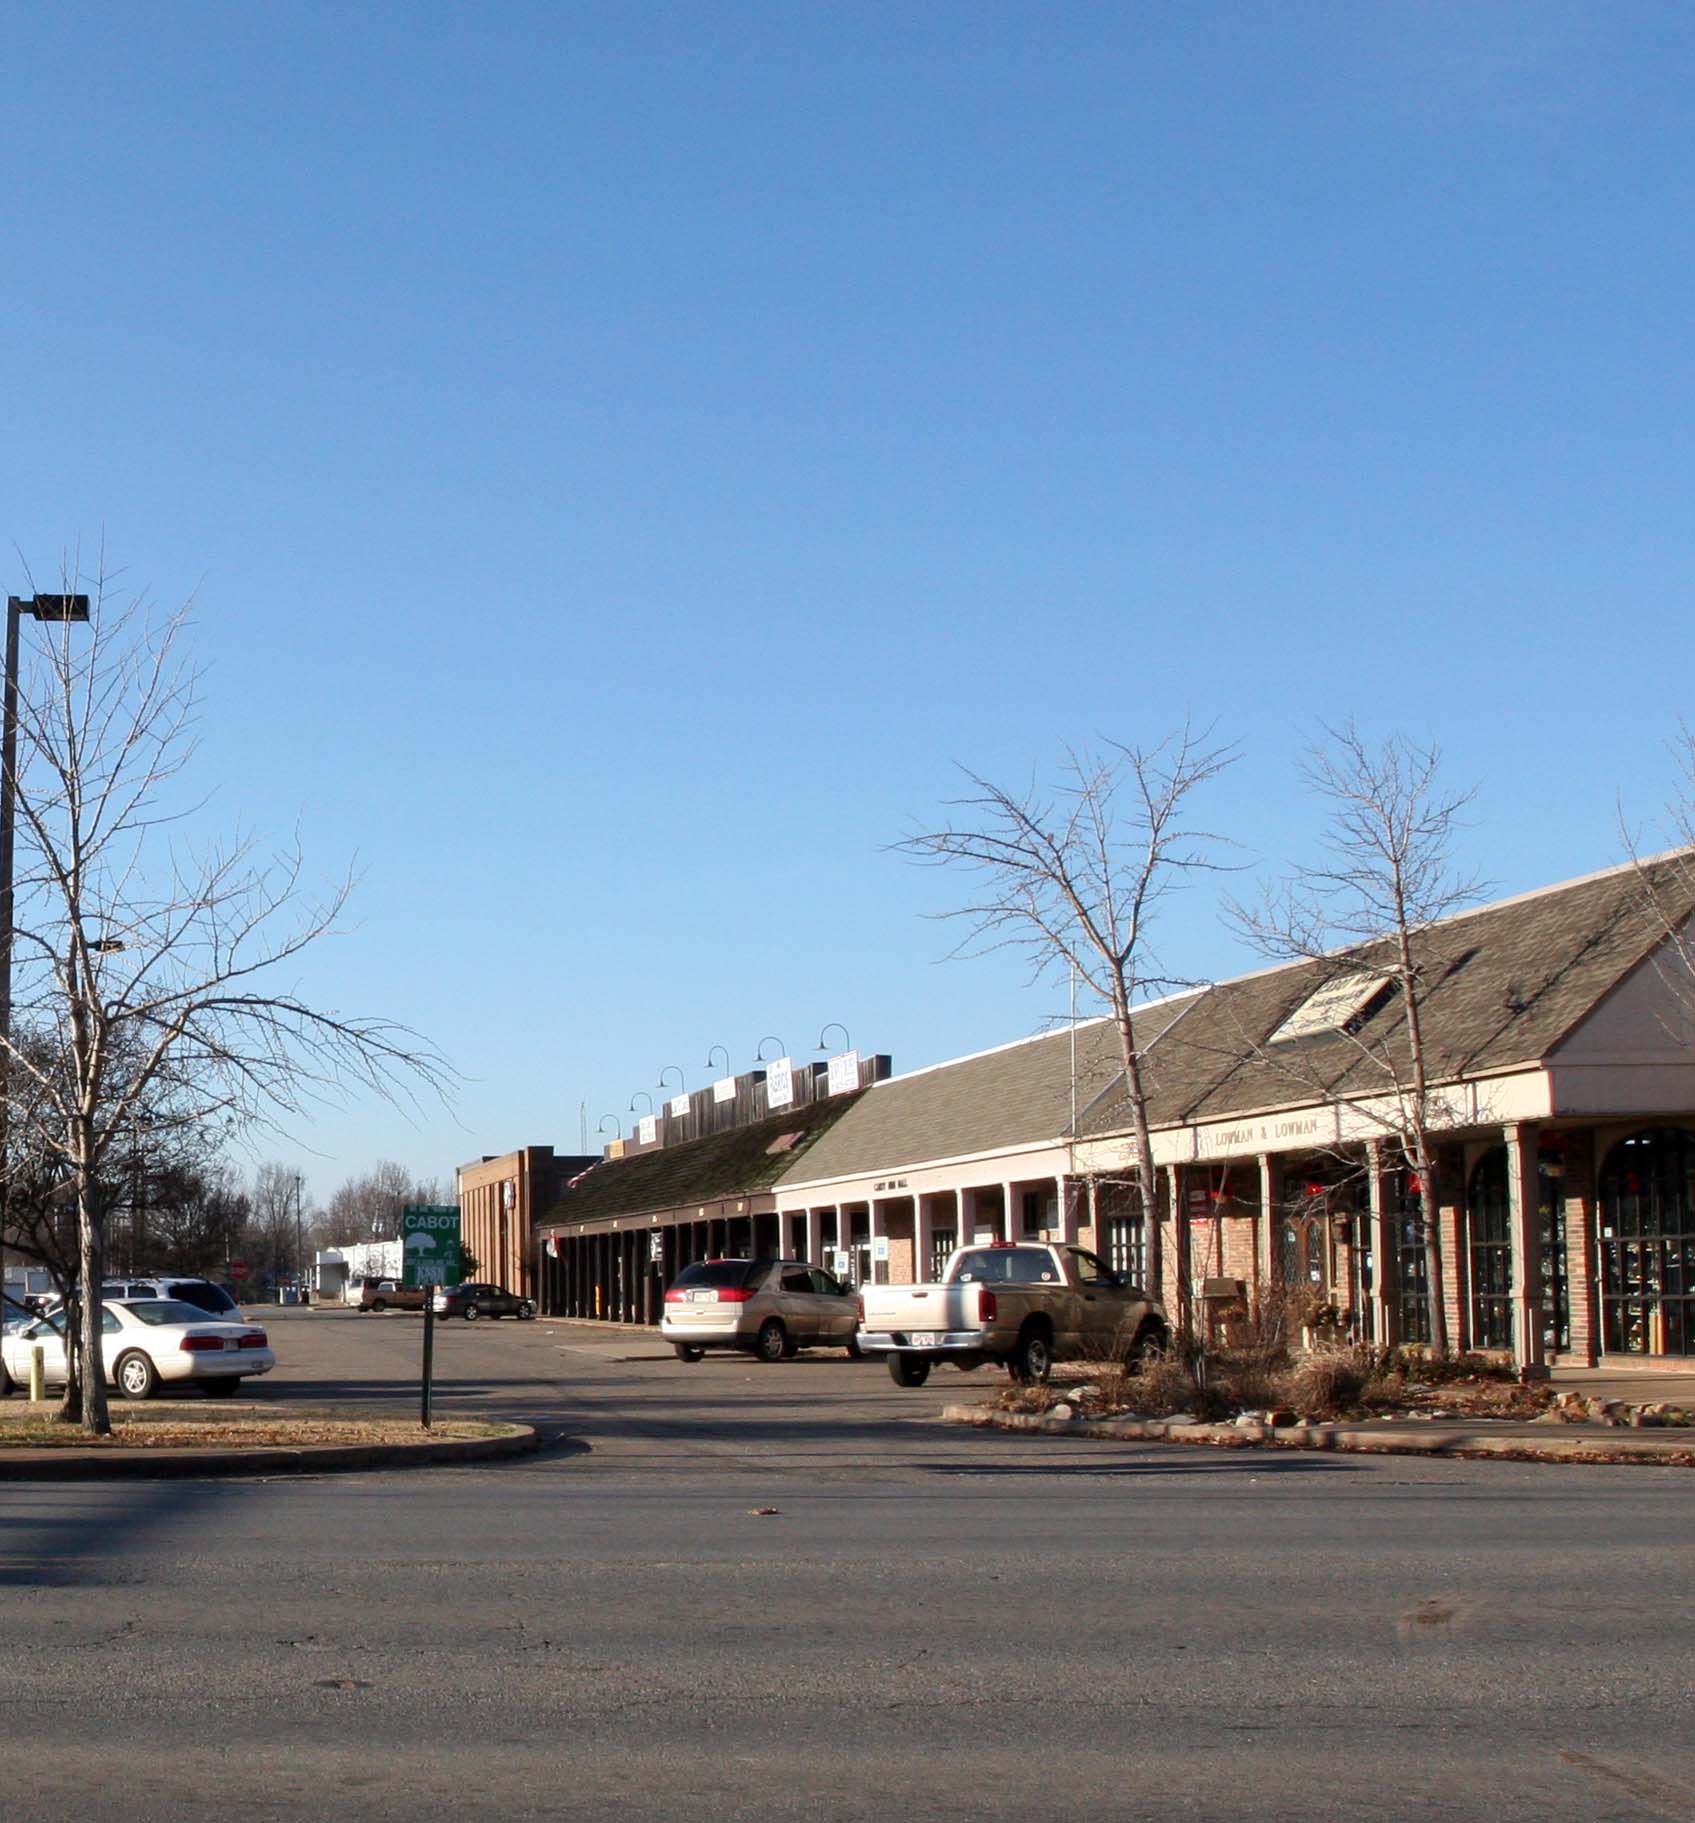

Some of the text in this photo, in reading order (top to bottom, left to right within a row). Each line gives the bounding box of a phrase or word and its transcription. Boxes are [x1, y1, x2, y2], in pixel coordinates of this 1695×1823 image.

[1215, 1119, 1318, 1147] LOWMAN & LOWMAN
[405, 1215, 459, 1229] CABOT
